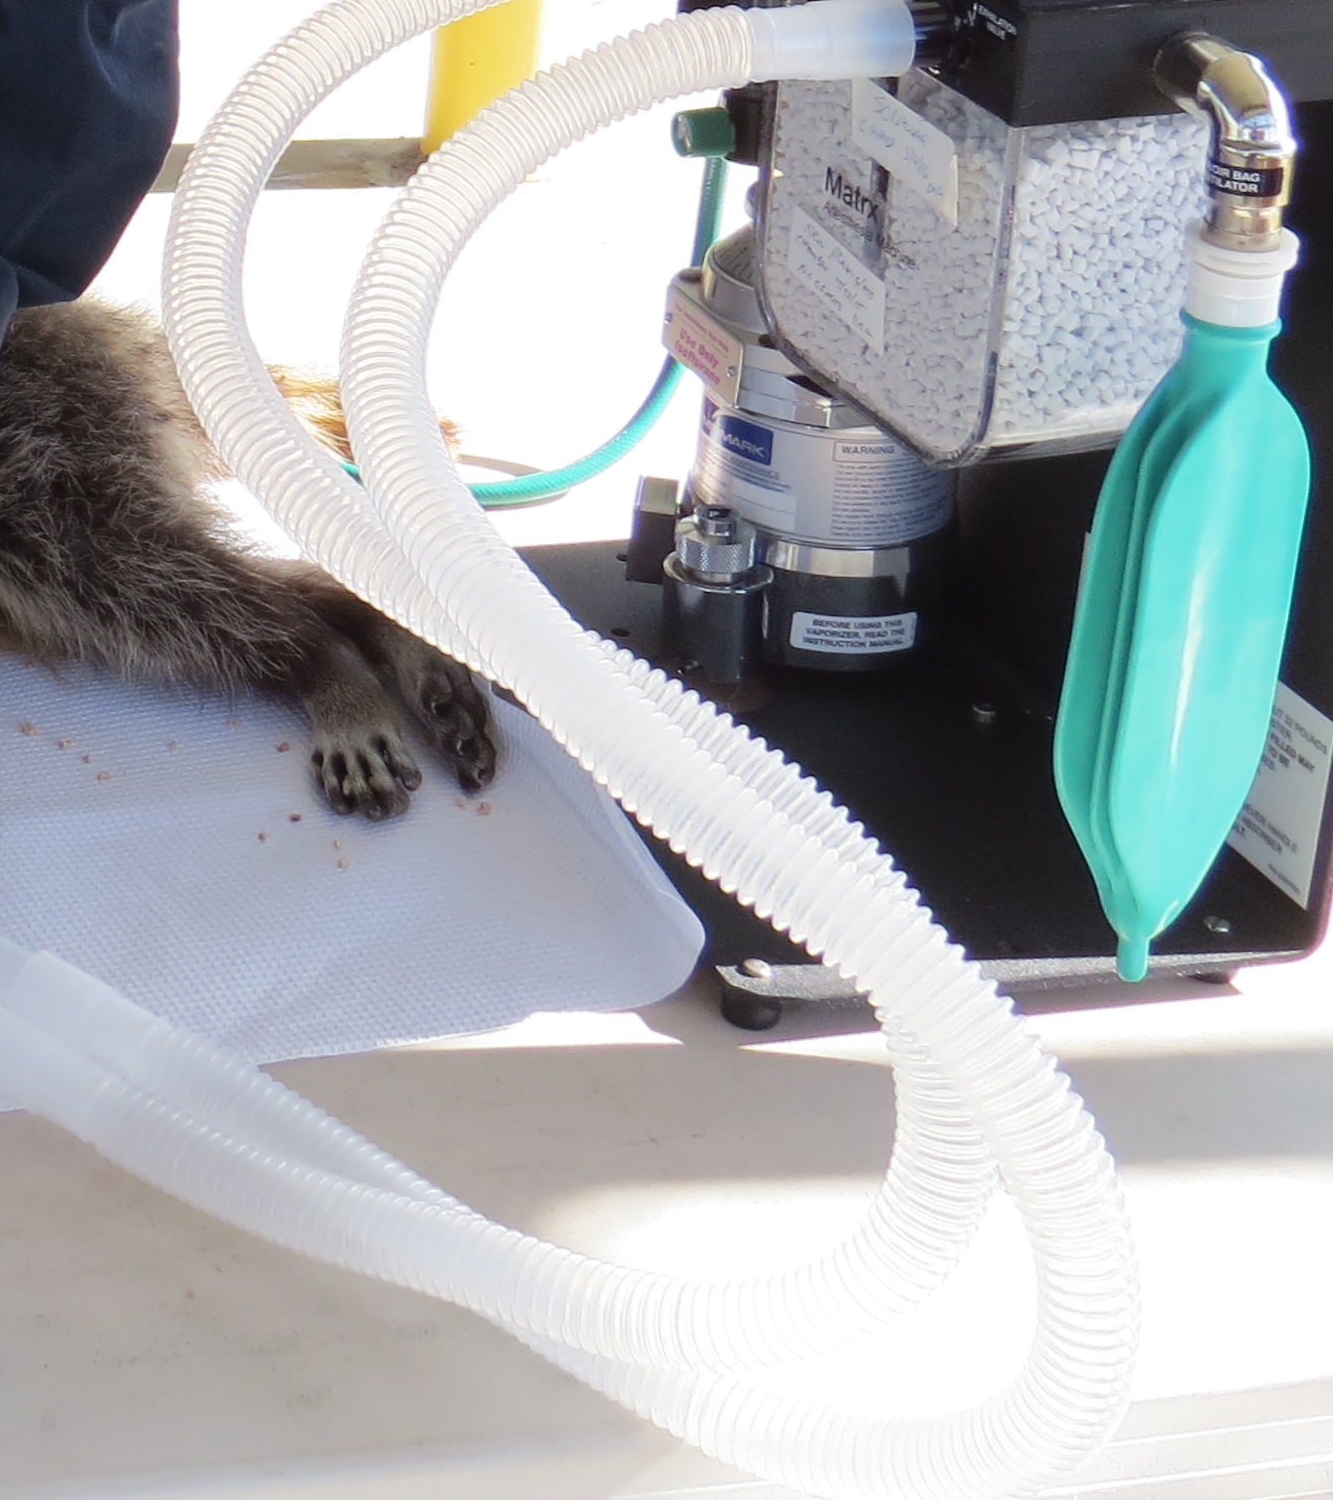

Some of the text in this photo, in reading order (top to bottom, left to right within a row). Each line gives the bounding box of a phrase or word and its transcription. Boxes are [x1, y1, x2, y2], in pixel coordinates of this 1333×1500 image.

[1232, 169, 1260, 183] BAG
[824, 165, 879, 225] Matrx
[698, 344, 720, 370] Only
[841, 445, 895, 455] WARNING
